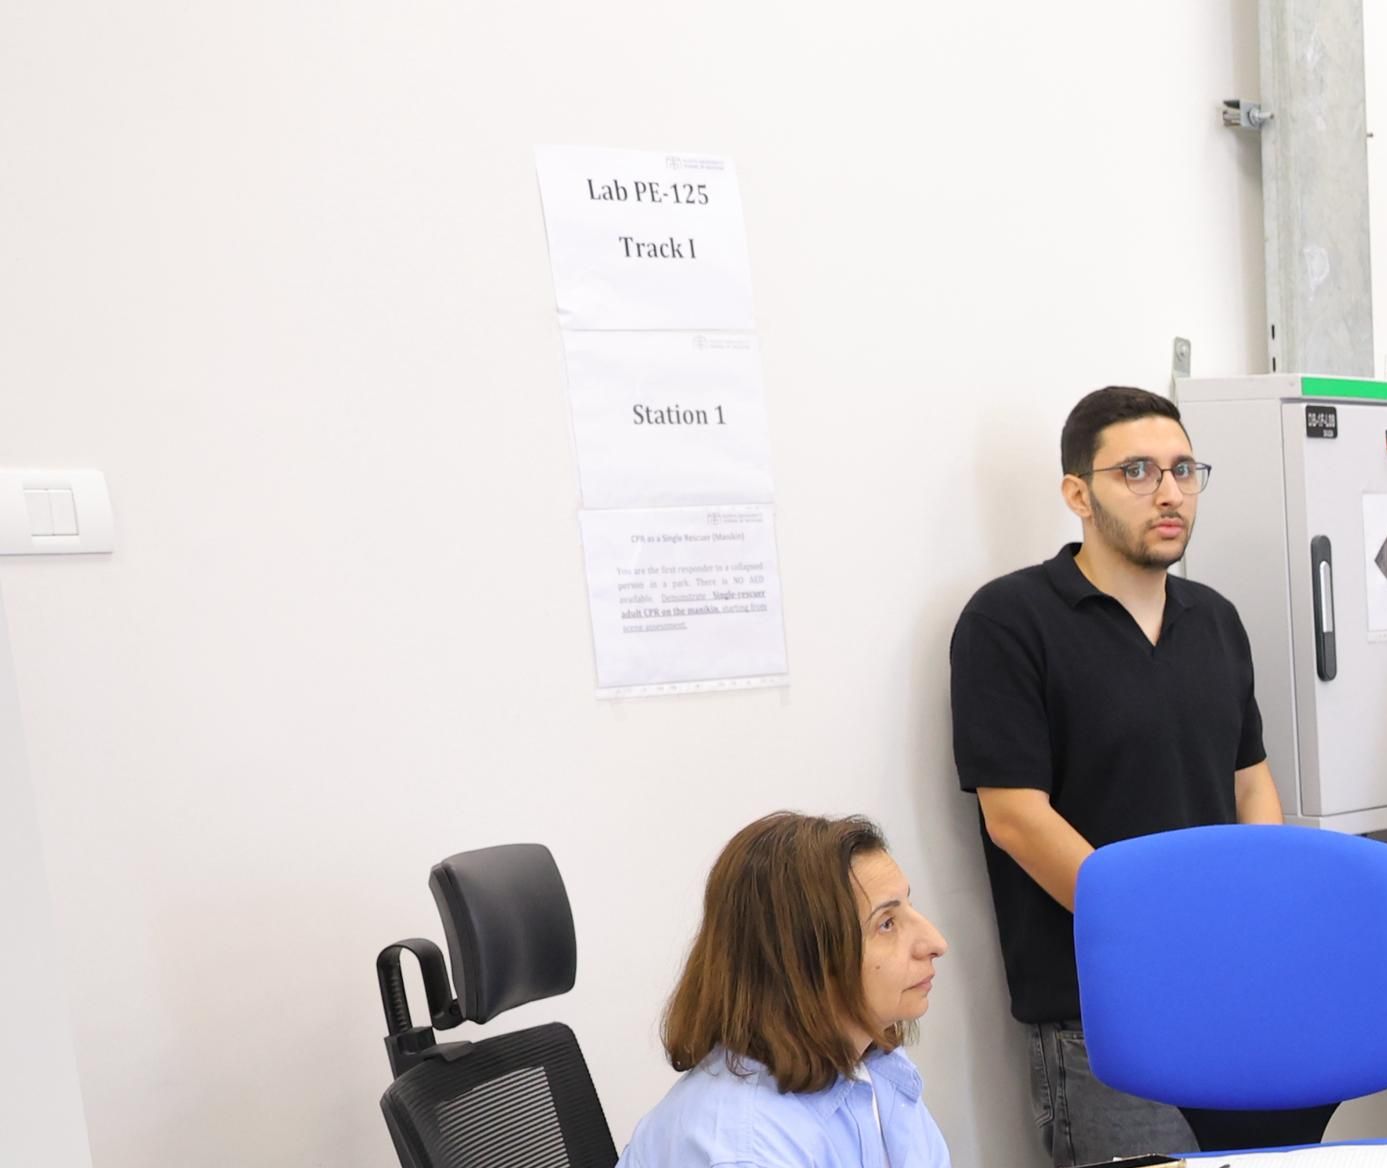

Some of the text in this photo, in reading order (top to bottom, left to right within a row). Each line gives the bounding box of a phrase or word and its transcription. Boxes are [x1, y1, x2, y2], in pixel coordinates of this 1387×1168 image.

[586, 178, 710, 205] Lab PE-125
[618, 236, 684, 259] Track
[632, 403, 727, 425] Station 1
[631, 535, 645, 543] CPR
[662, 534, 682, 544] Single
[684, 534, 710, 542] Rescuer
[617, 567, 632, 575] You
[648, 566, 658, 574] the
[661, 565, 675, 573] first
[678, 564, 713, 574] responder
[731, 562, 763, 572] collapsed
[618, 581, 644, 591] person
[650, 579, 657, 588] in
[662, 593, 706, 602] Demonstrate
[622, 608, 642, 618] adult
[644, 608, 659, 617] CPR
[662, 609, 671, 617] on
[673, 607, 685, 616] the
[722, 605, 749, 613] starting
[751, 603, 767, 611] from
[623, 625, 643, 633] scene
